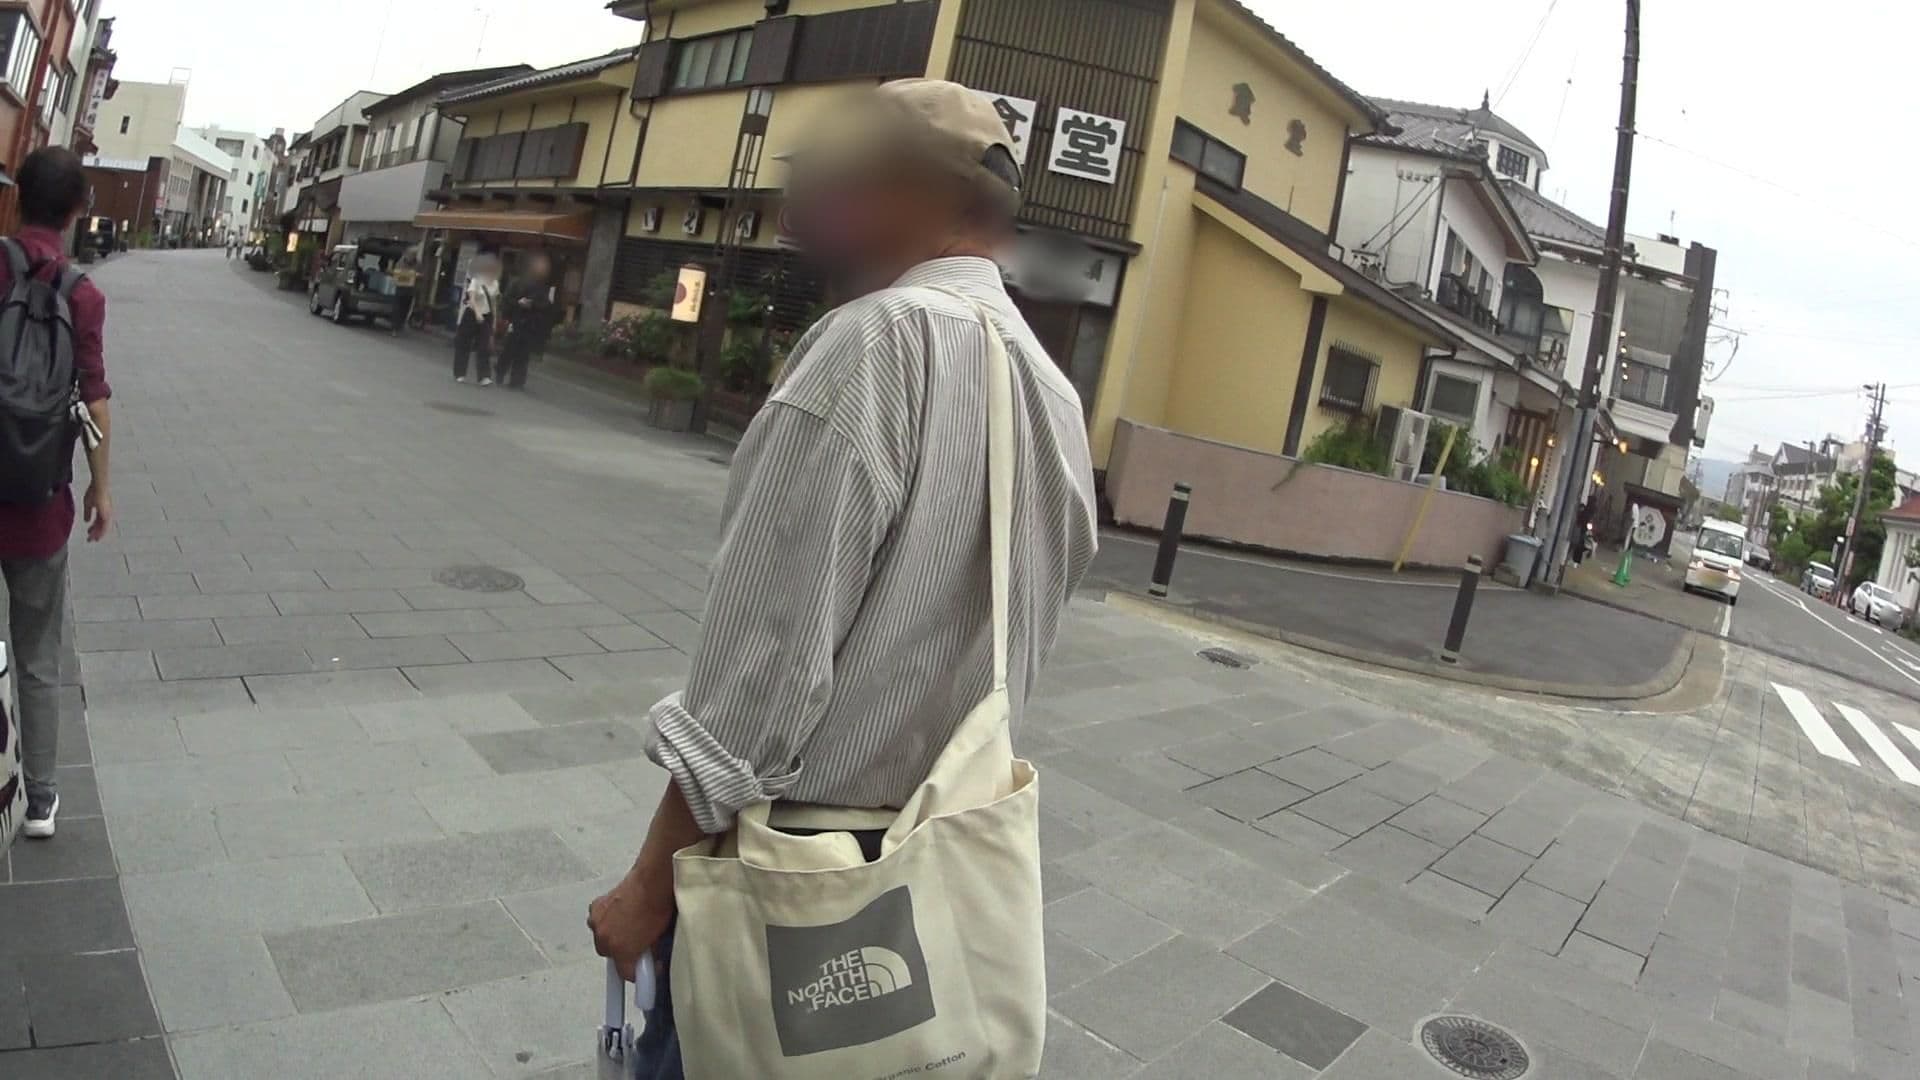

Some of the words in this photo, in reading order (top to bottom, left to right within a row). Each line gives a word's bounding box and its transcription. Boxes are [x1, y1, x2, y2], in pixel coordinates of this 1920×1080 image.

[820, 949, 862, 976] THE
[788, 967, 866, 1004] NORTH
[811, 984, 870, 1011] FACE
[925, 1051, 967, 1072] Cotton
